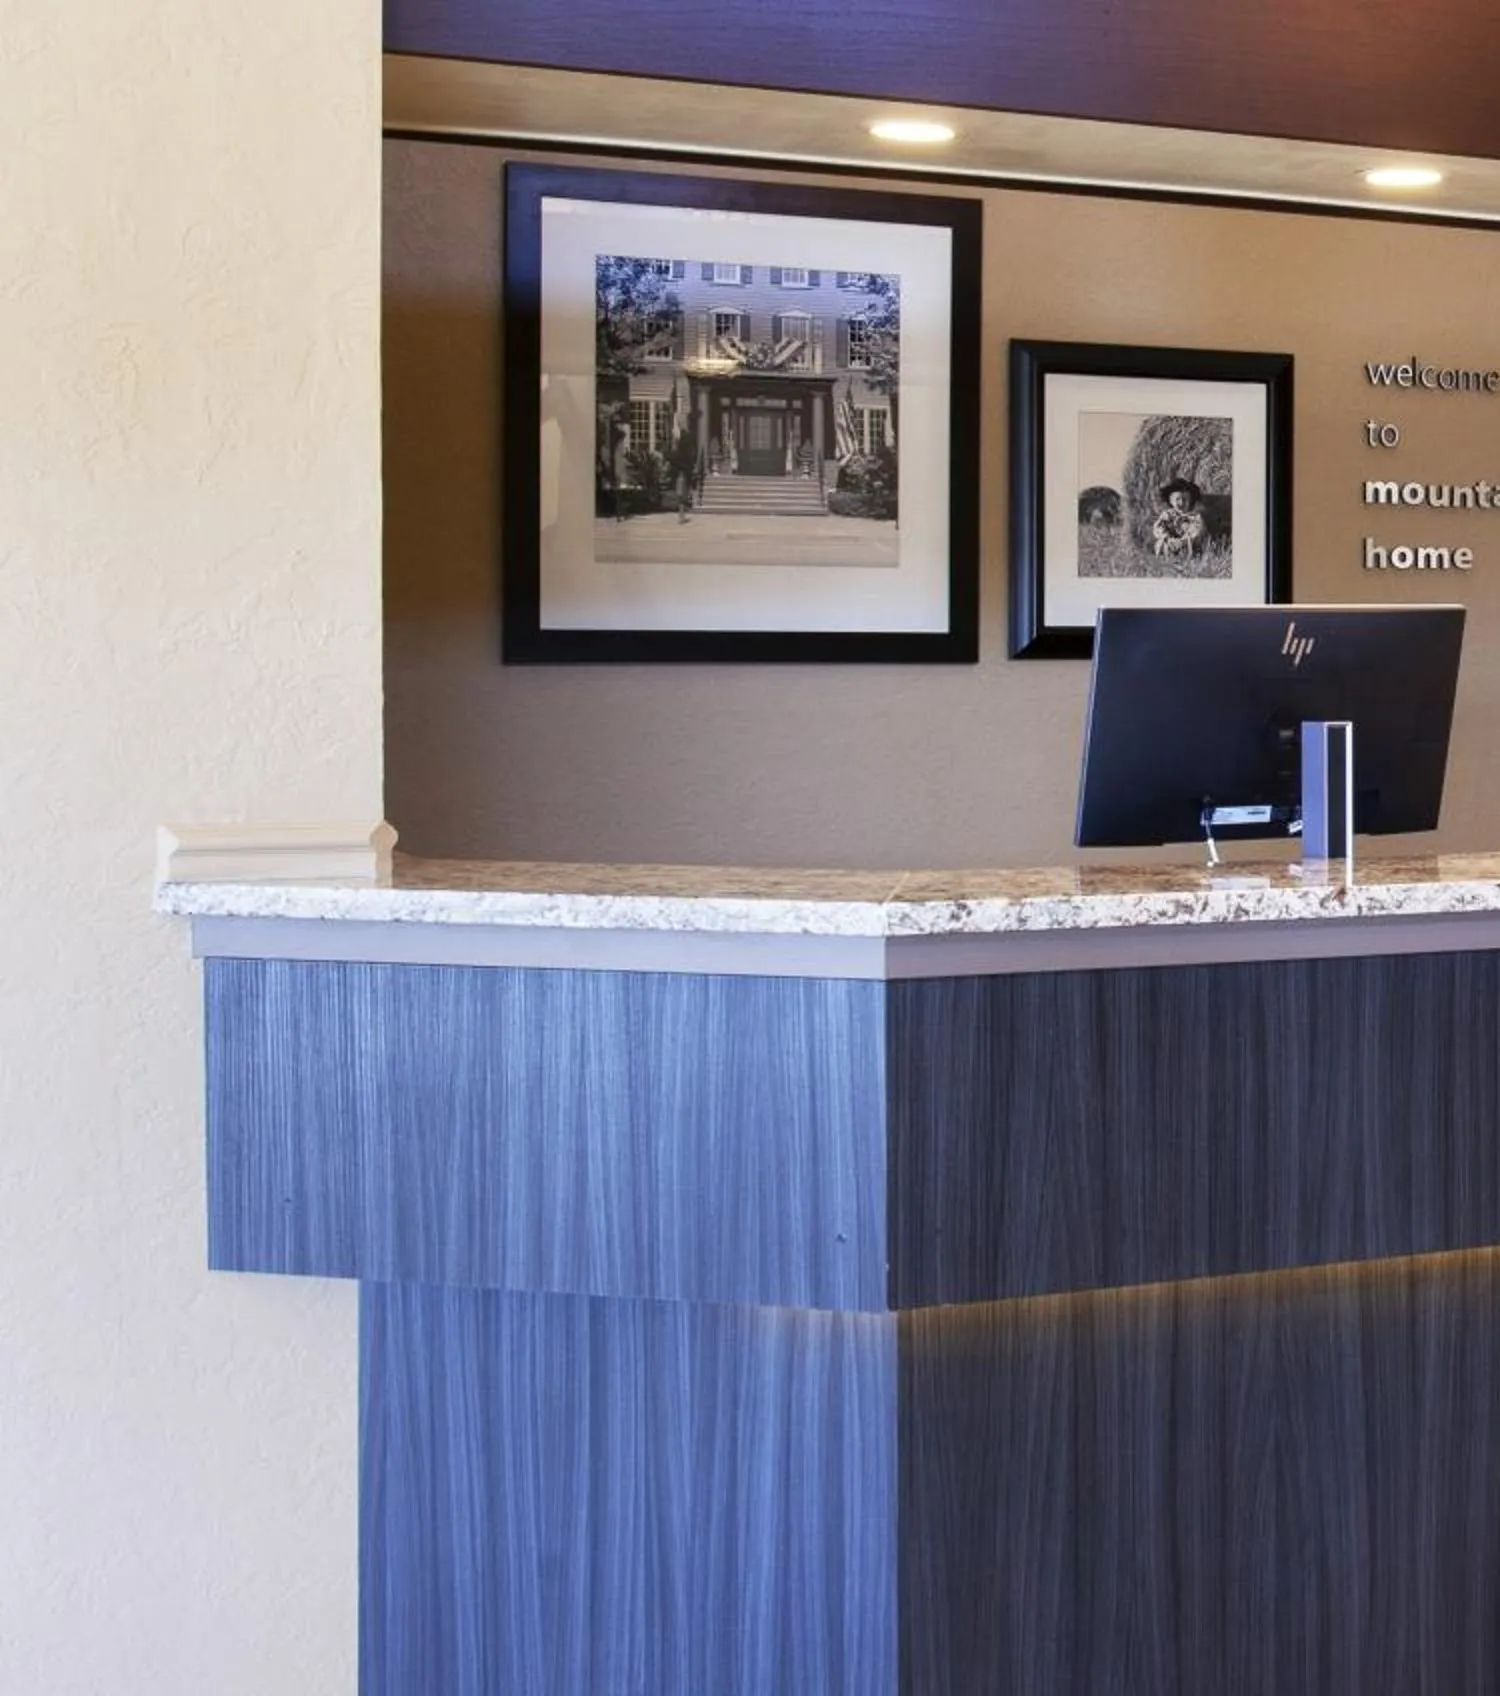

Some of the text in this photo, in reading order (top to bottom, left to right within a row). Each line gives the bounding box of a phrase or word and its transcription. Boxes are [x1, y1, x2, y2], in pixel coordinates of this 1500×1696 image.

[1365, 355, 1500, 393] welcome
[1366, 419, 1400, 448] to
[1364, 536, 1474, 570] home
[1281, 621, 1315, 667] hp
